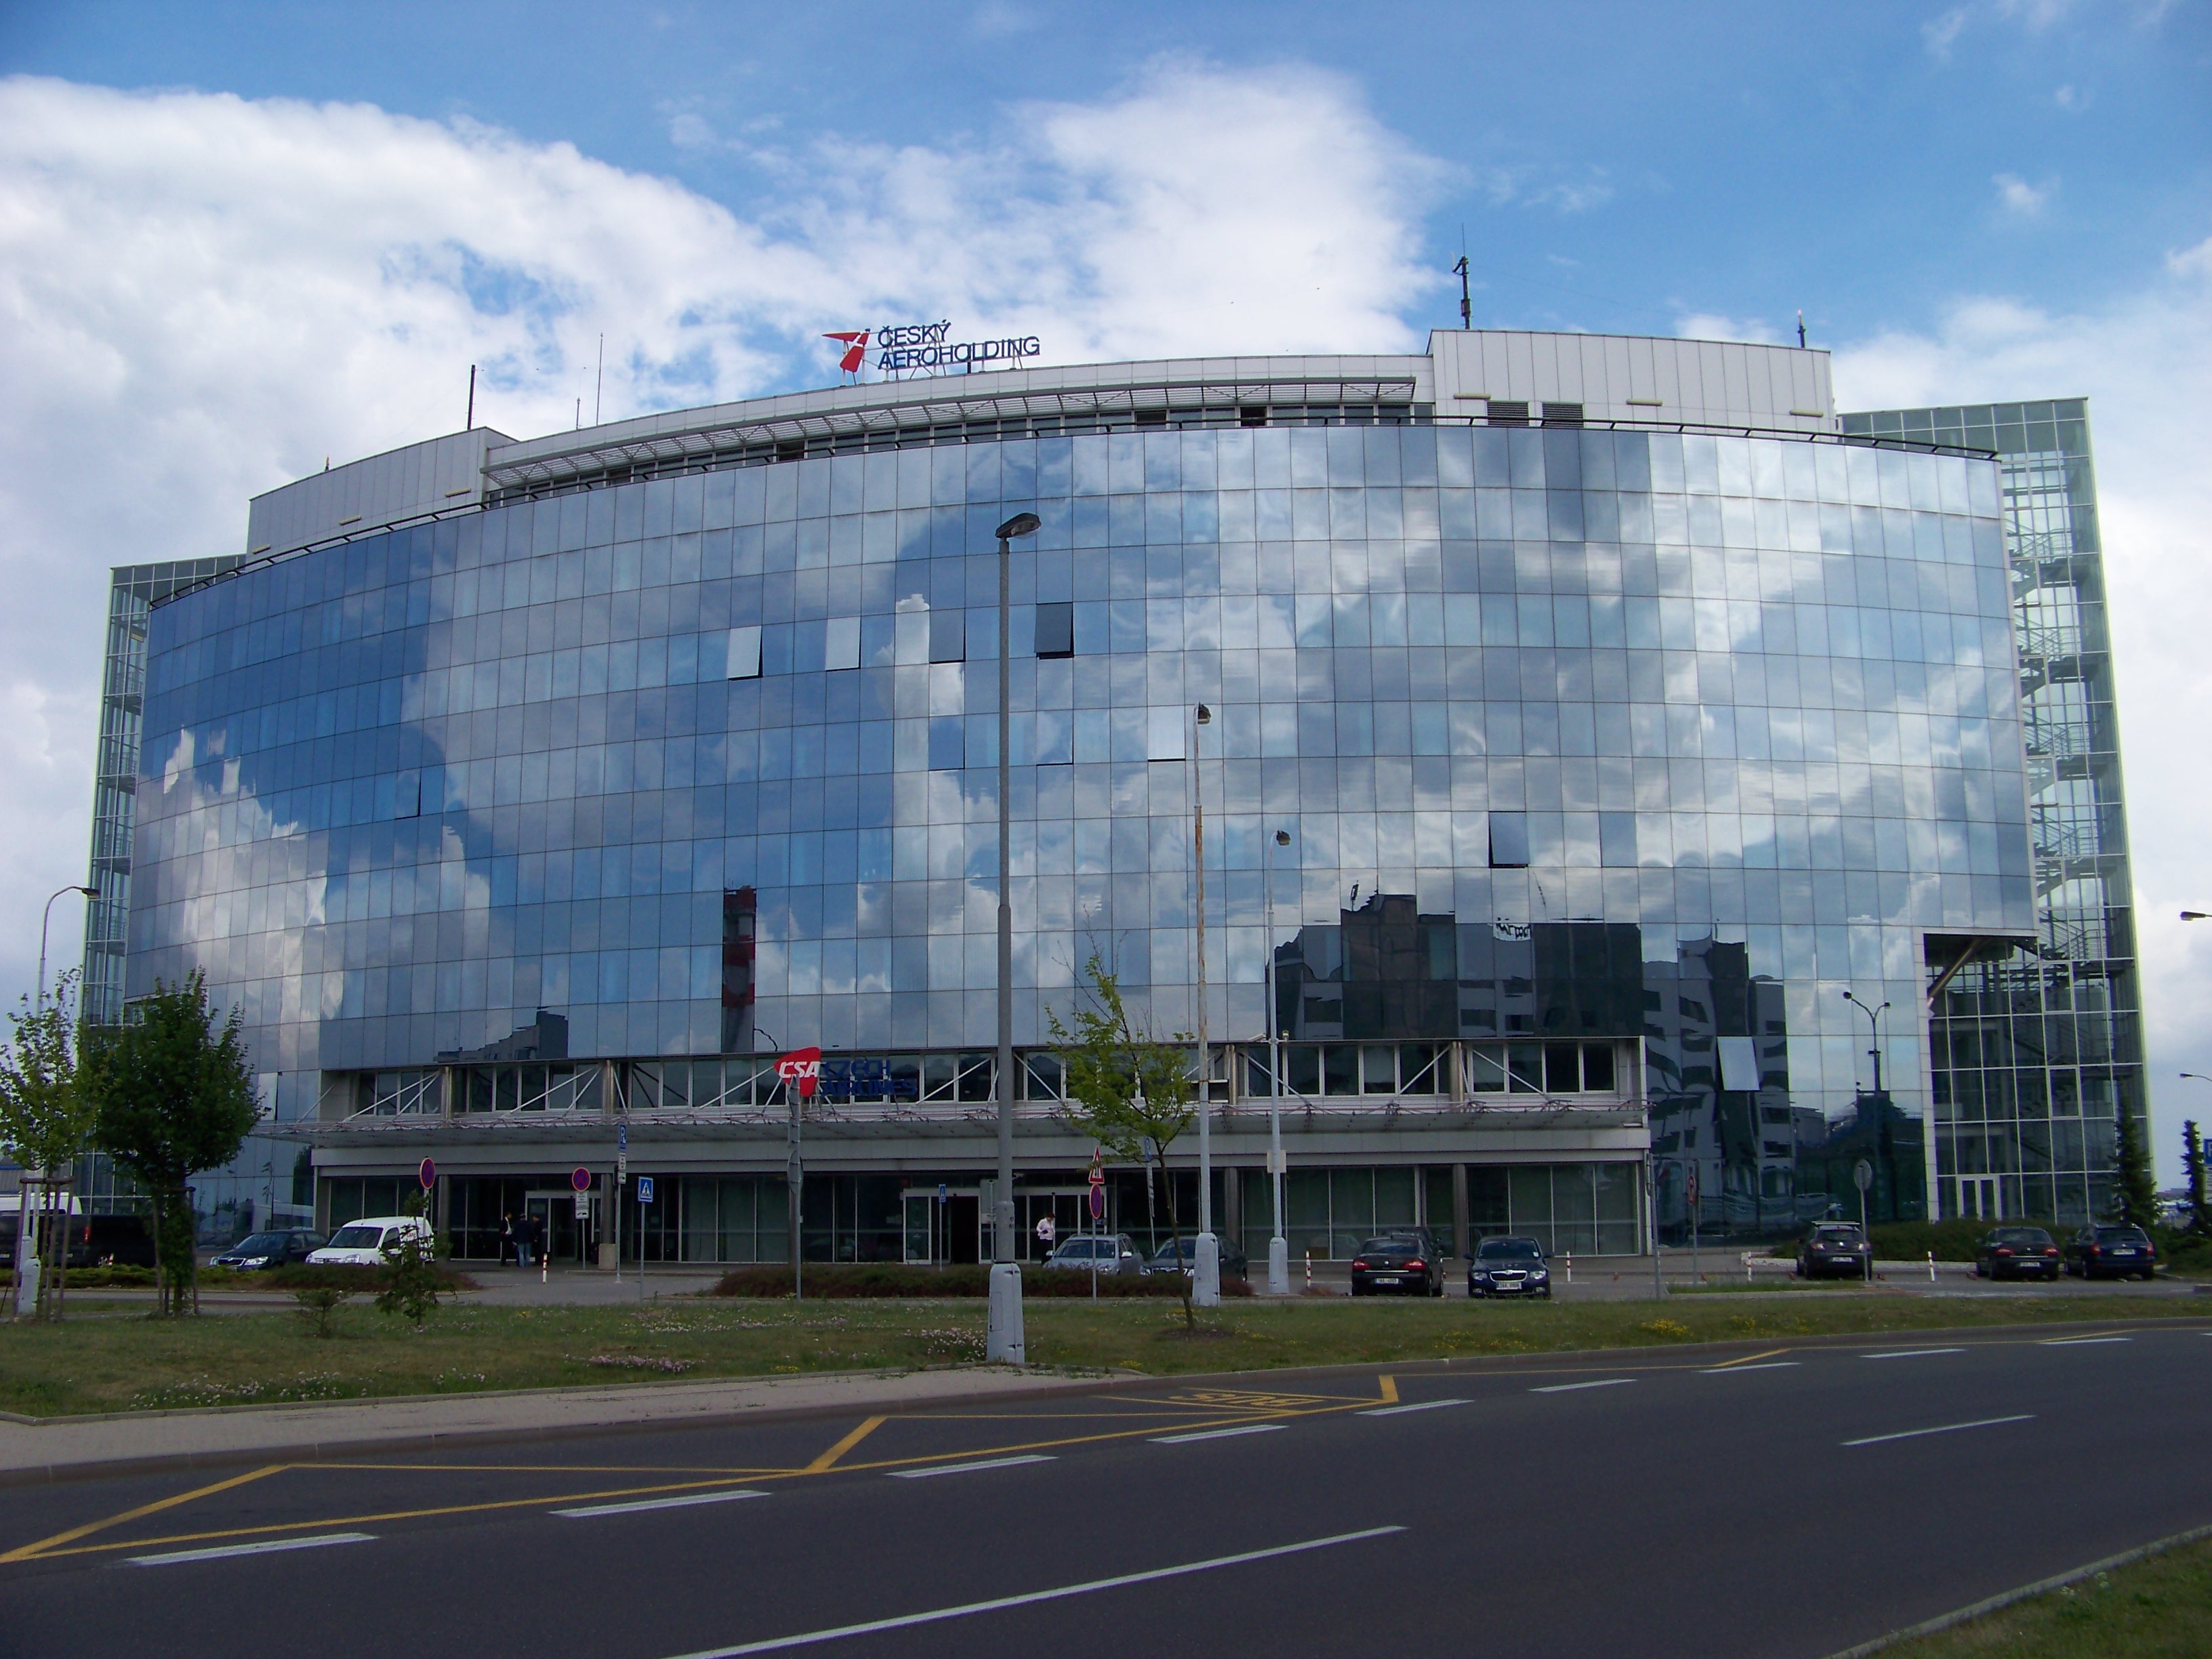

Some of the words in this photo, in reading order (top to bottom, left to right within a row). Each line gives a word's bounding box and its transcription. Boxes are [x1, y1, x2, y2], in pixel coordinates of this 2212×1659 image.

[878, 320, 951, 348] ČESKÝ
[878, 337, 1040, 369] AEROHOLDING
[824, 1059, 890, 1078] CZECH
[822, 1080, 918, 1095] AIRLINES
